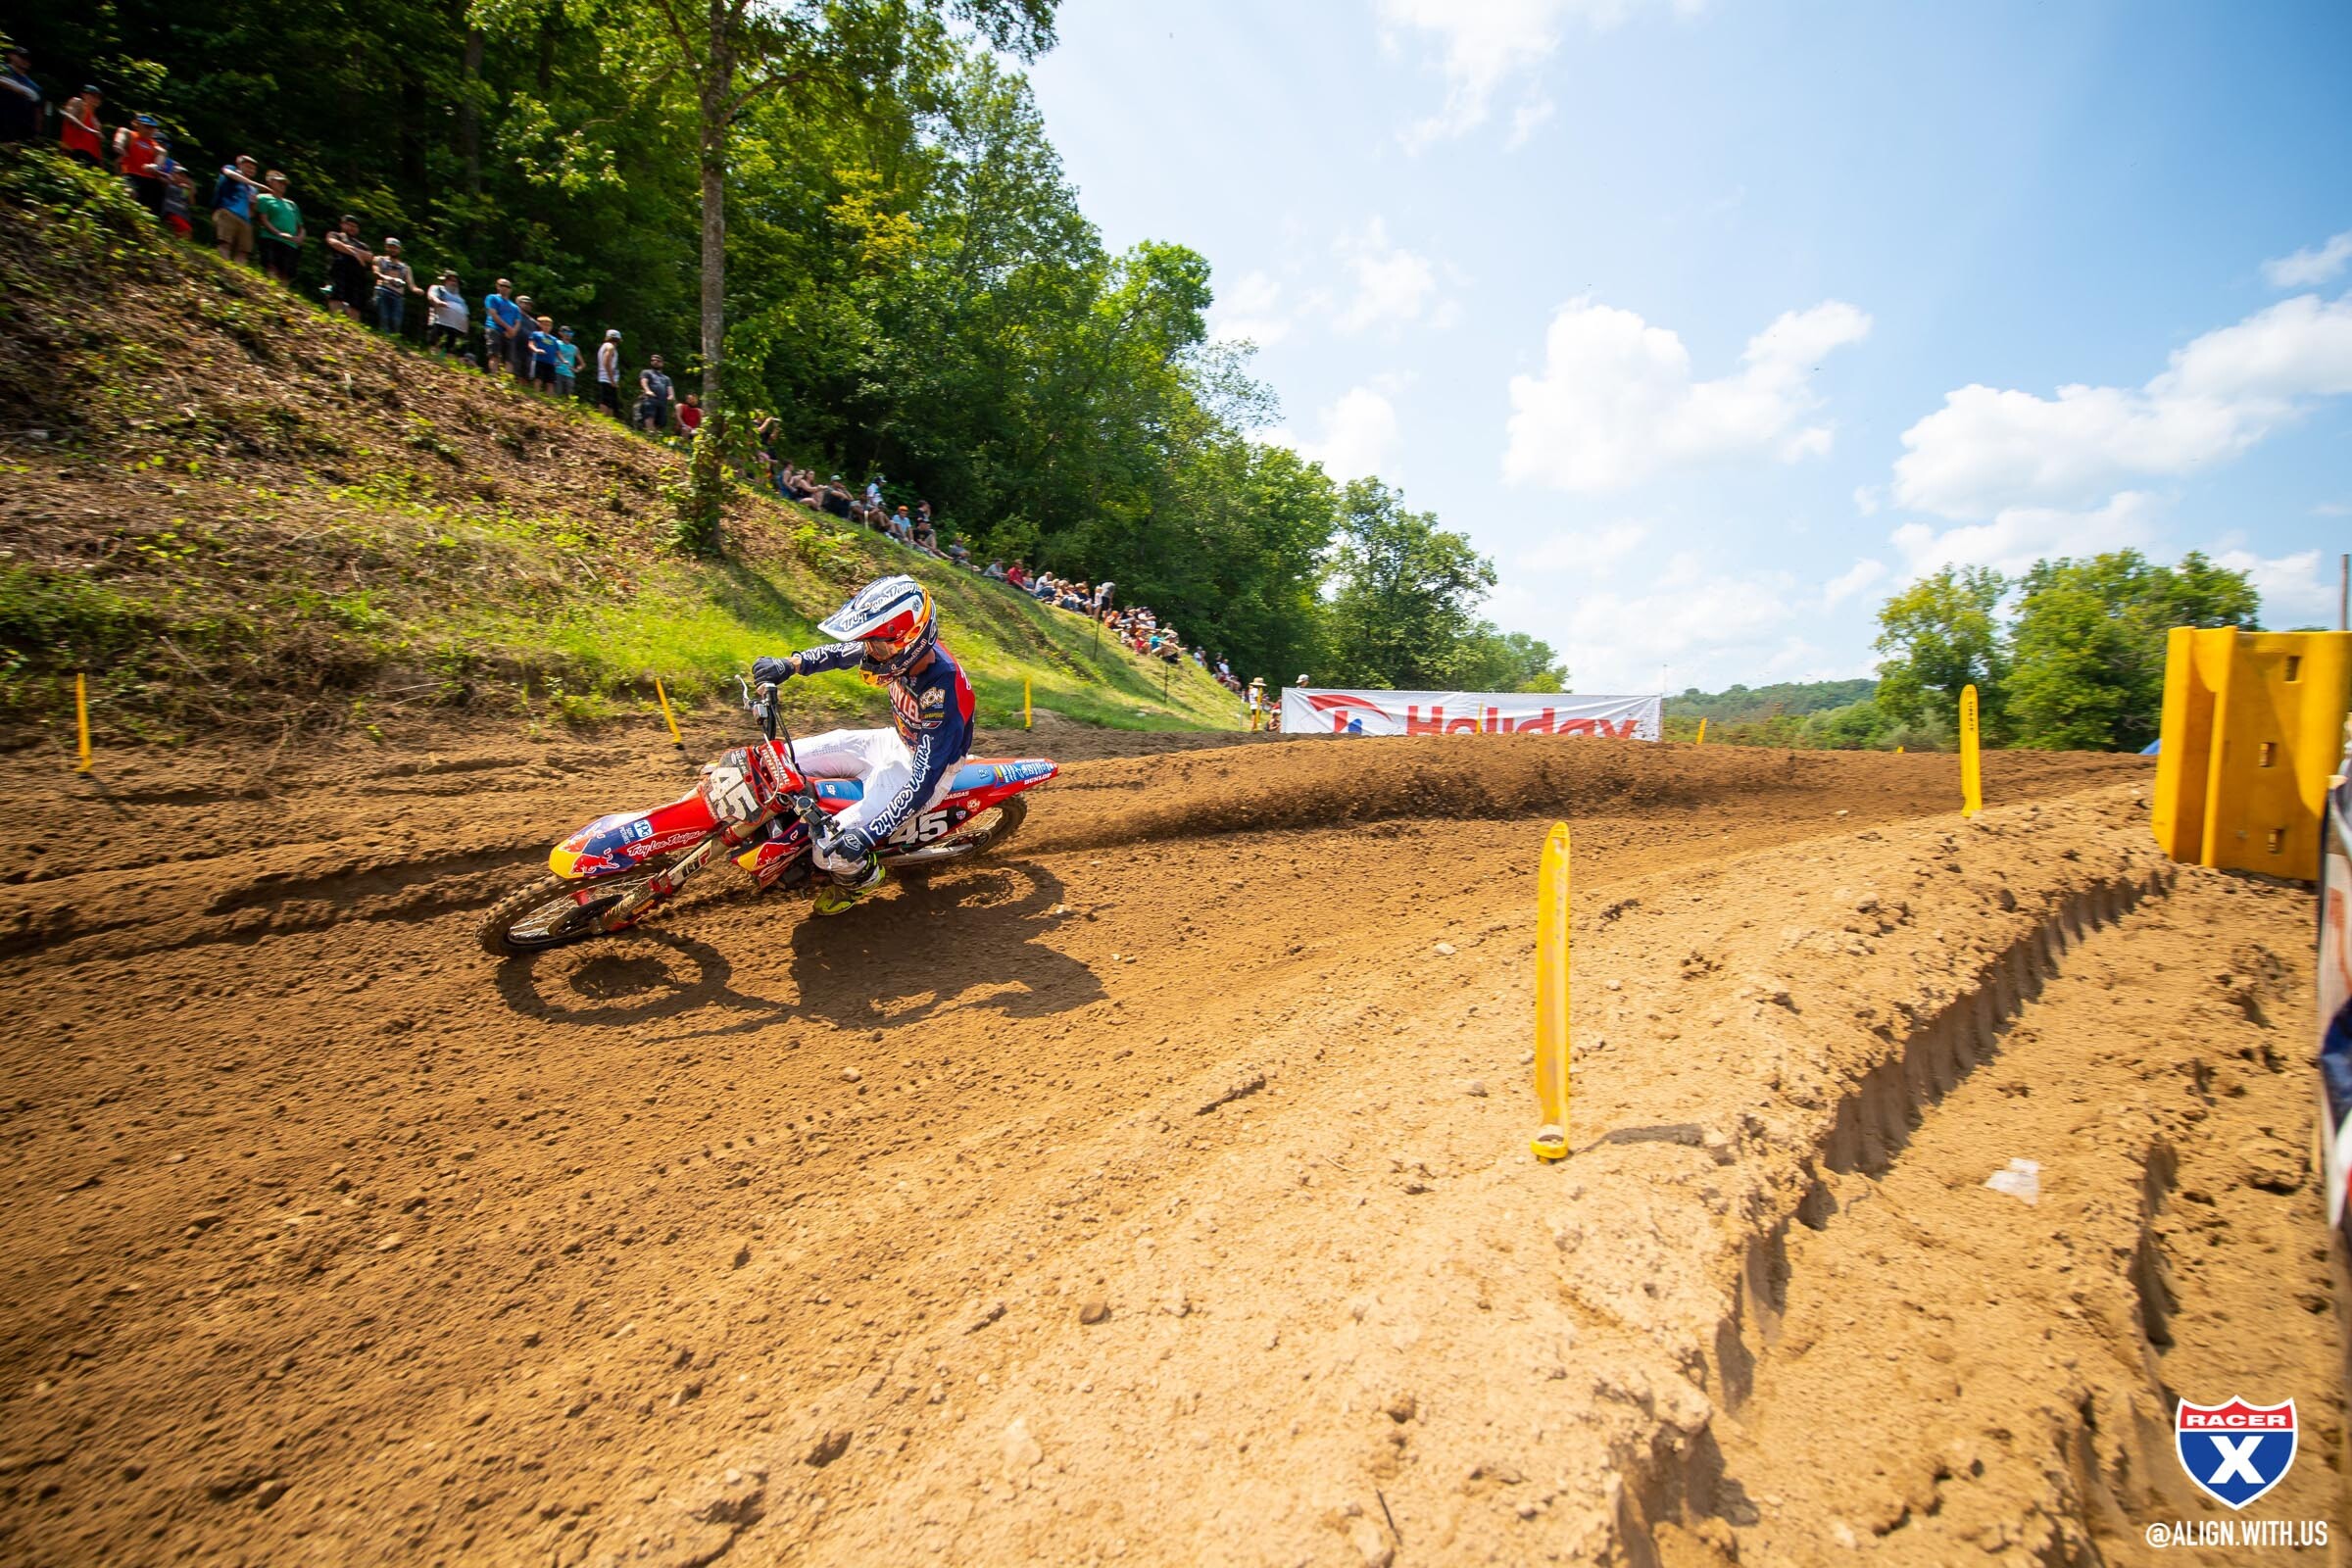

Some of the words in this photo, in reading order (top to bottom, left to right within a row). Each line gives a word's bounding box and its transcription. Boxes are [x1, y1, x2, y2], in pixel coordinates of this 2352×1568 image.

[1024, 773, 1052, 785] DUNLOP
[709, 767, 760, 821] 45
[888, 809, 949, 844] 45
[627, 840, 652, 857] Troy
